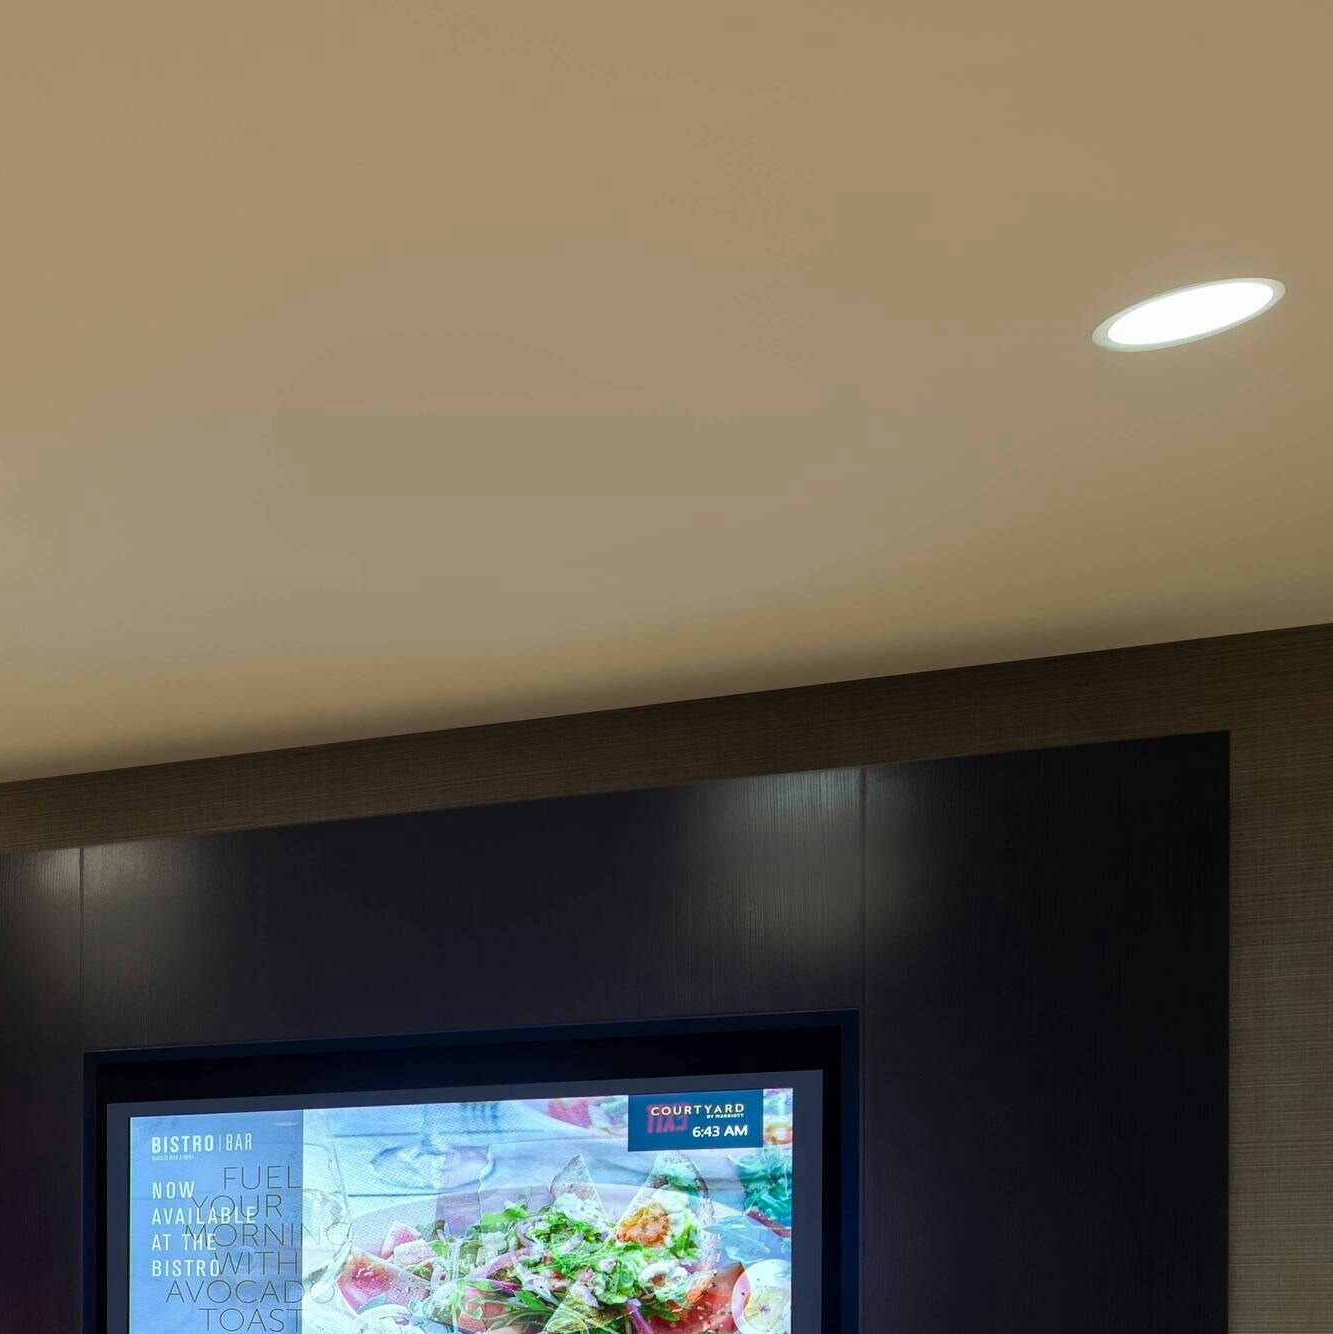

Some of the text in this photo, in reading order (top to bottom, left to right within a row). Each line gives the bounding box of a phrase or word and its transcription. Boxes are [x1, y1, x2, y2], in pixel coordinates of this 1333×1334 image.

[651, 1104, 744, 1116] COURTYARD
[692, 1125, 748, 1137] 6:43 AM
[151, 1133, 252, 1153] BISTRO BAR
[223, 1165, 302, 1190] FUEL
[152, 1182, 195, 1199] NOW
[151, 1206, 256, 1225] AVAILABLE
[190, 1195, 282, 1218] YOUR
[151, 1233, 217, 1251] AT THE
[152, 1260, 220, 1278] BISTRO
[214, 1251, 299, 1275] WITH
[165, 1279, 335, 1304] AVOCADO
[198, 1308, 306, 1332] TOAST
